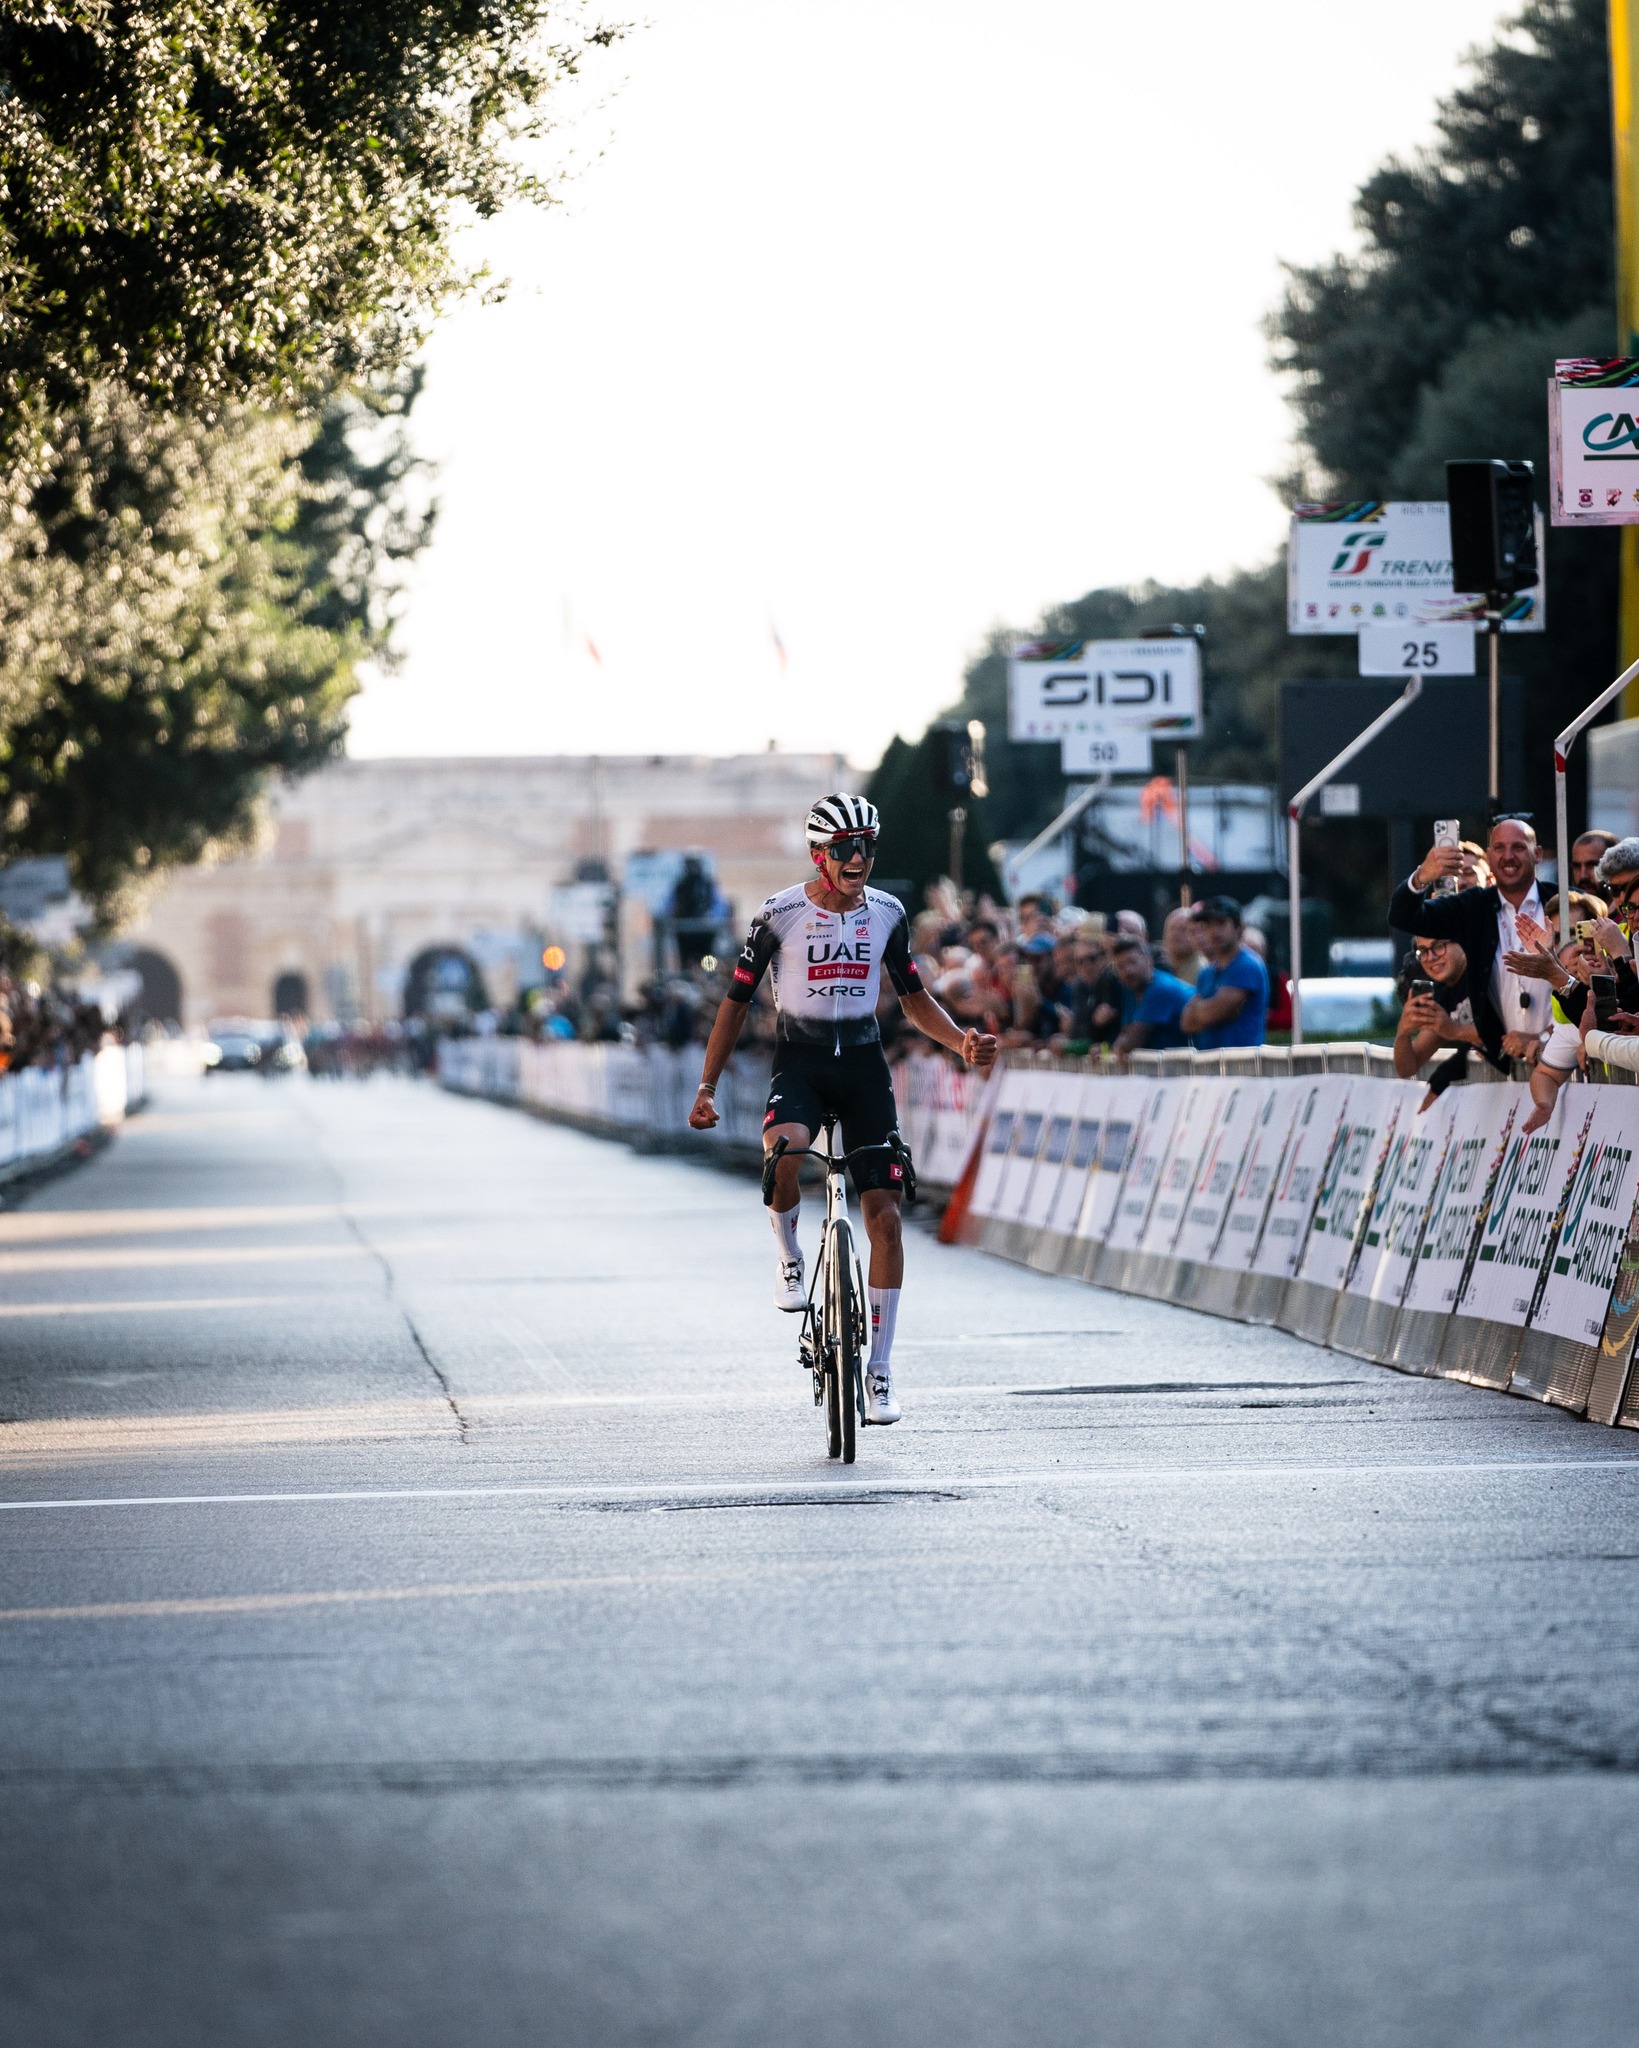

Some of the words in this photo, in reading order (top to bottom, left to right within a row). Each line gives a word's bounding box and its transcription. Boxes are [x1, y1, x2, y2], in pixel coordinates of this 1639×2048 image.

[1402, 641, 1439, 668] 25
[1042, 669, 1172, 706] SIDI
[1089, 741, 1119, 765] 50
[811, 814, 830, 827] MET
[772, 901, 807, 917] Analog
[875, 898, 904, 916] Analog
[807, 942, 871, 964] UAE
[814, 966, 865, 977] Emirates
[806, 985, 866, 998] XRG
[1495, 1207, 1553, 1269] AGRICOLE
[1572, 1219, 1624, 1290] AGRICOLE
